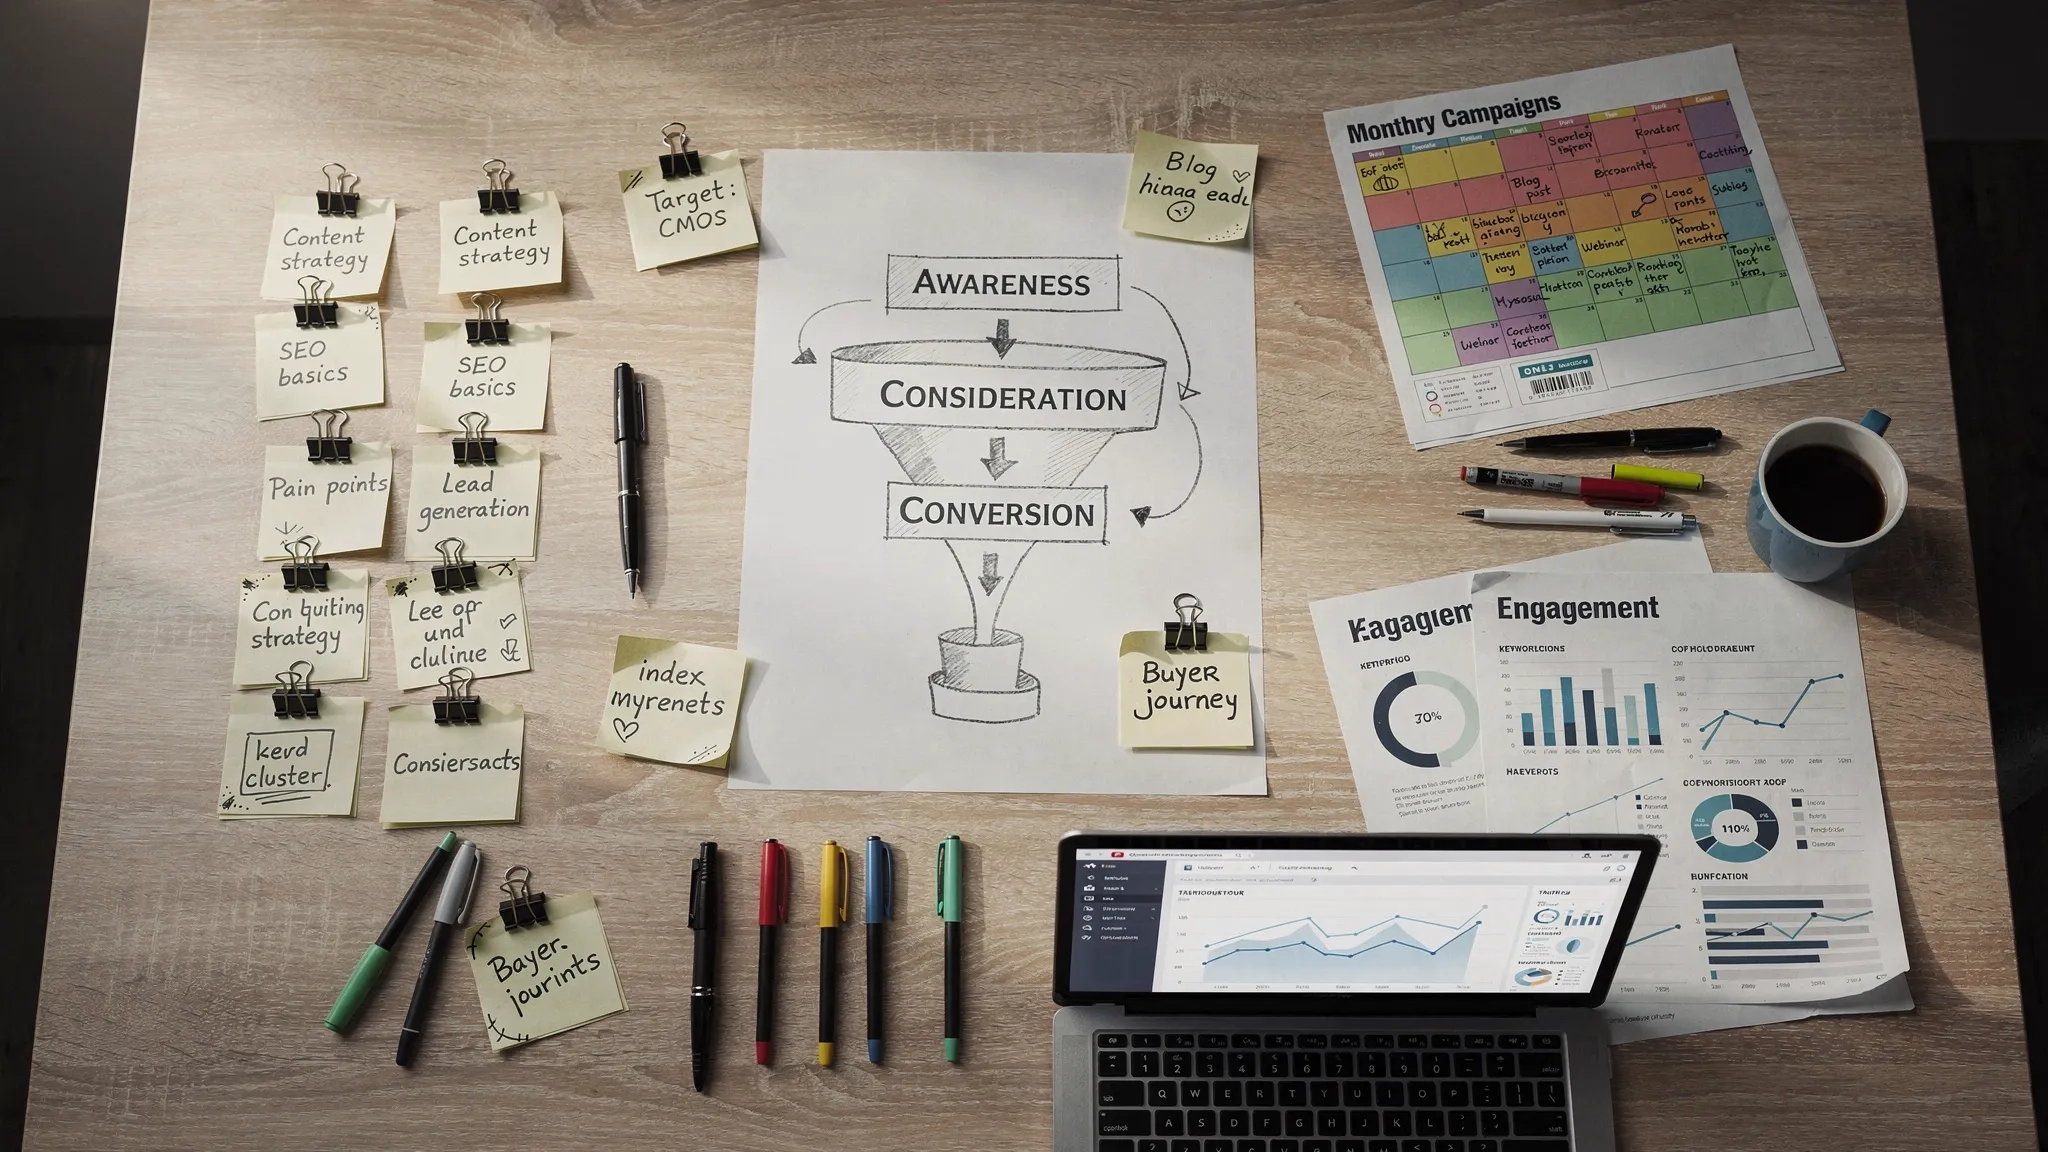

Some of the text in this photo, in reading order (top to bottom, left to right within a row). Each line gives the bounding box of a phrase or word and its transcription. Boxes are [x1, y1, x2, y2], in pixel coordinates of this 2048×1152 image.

[1347, 95, 1562, 144] Monthry Campaigns
[1166, 151, 1217, 184] Blog
[1511, 175, 1541, 188] Blog
[454, 218, 538, 245] Content
[659, 209, 727, 238] CMOS
[283, 225, 365, 247] Content
[1580, 237, 1626, 253] Webinar
[280, 250, 368, 275] strategy
[459, 245, 550, 266] strategy
[279, 340, 326, 360] SEO
[457, 356, 507, 374] SEO
[279, 364, 349, 387] basics
[449, 378, 516, 398] basics
[269, 472, 388, 504] Pain points
[442, 471, 493, 493] Lead
[417, 498, 530, 532] generation
[252, 601, 292, 622] Con
[408, 600, 443, 622] Lee
[1497, 596, 1660, 625] Engagement
[424, 619, 465, 642] und
[251, 625, 341, 655] strategy
[638, 659, 706, 686] index
[1133, 688, 1237, 720] journey
[393, 748, 521, 775] Consiersacts
[245, 764, 323, 788] cluster
[1722, 824, 1750, 833] 110%
[505, 952, 601, 1017] jourints
[1174, 1065, 1180, 1073] 2
[1207, 1065, 1213, 1073] 3
[1238, 1065, 1245, 1073] 4
[1272, 1065, 1277, 1073] 5
[1304, 1065, 1310, 1073] 6
[1336, 1065, 1343, 1073] 7
[1369, 1065, 1375, 1073] 8
[1401, 1065, 1407, 1073] 9
[1433, 1065, 1440, 1073] 0
[1158, 1090, 1166, 1098] Q
[1190, 1090, 1200, 1098] W
[1257, 1090, 1263, 1098] R
[1354, 1090, 1361, 1098] U
[1165, 1119, 1173, 1127] A
[1198, 1119, 1205, 1127] S
[1231, 1119, 1238, 1127] D
[1264, 1119, 1270, 1127] F
[1296, 1119, 1303, 1127] G
[1328, 1119, 1336, 1127] H
[1362, 1119, 1367, 1127] J
[1394, 1119, 1400, 1127] K
[1428, 1119, 1433, 1127] L
